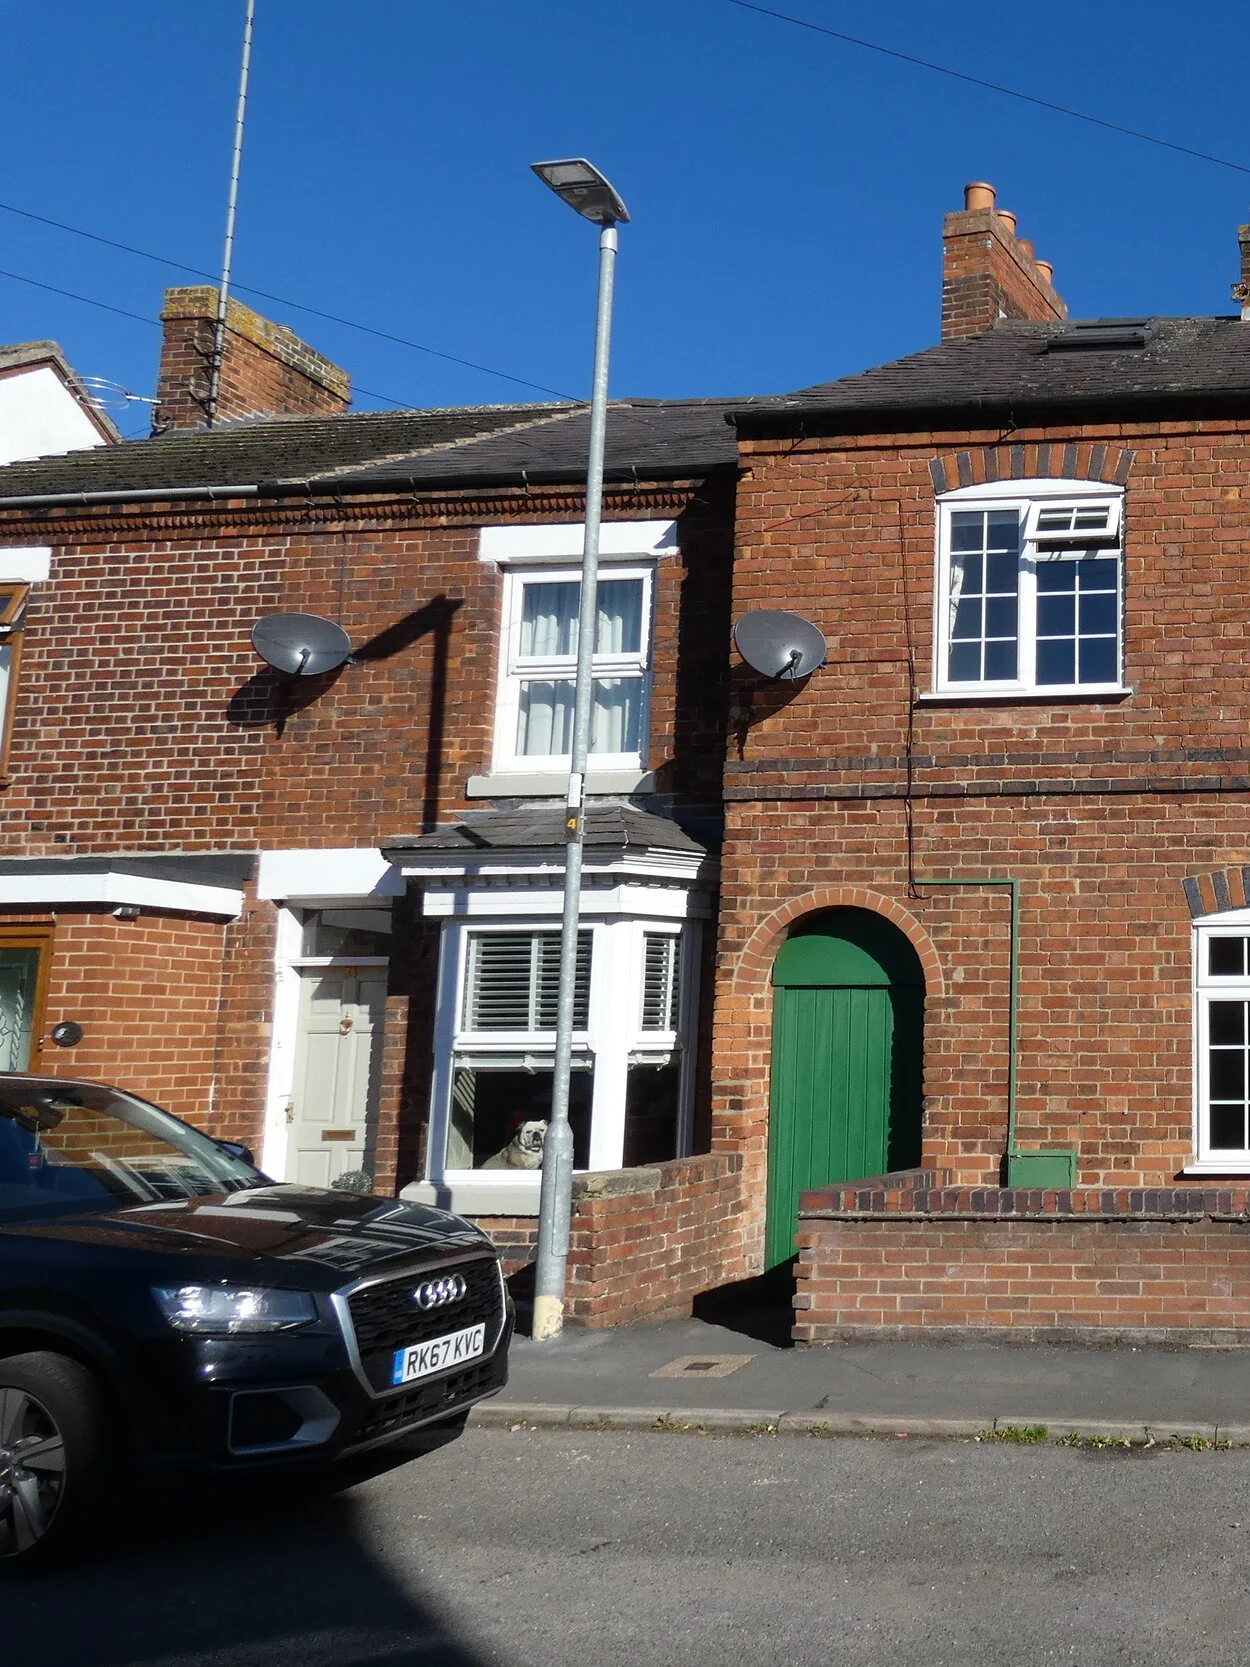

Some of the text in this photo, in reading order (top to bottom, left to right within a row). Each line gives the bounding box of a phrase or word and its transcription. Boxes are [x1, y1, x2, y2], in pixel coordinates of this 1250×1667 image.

[567, 818, 577, 830] 4
[406, 1329, 482, 1376] RK67 KVC
